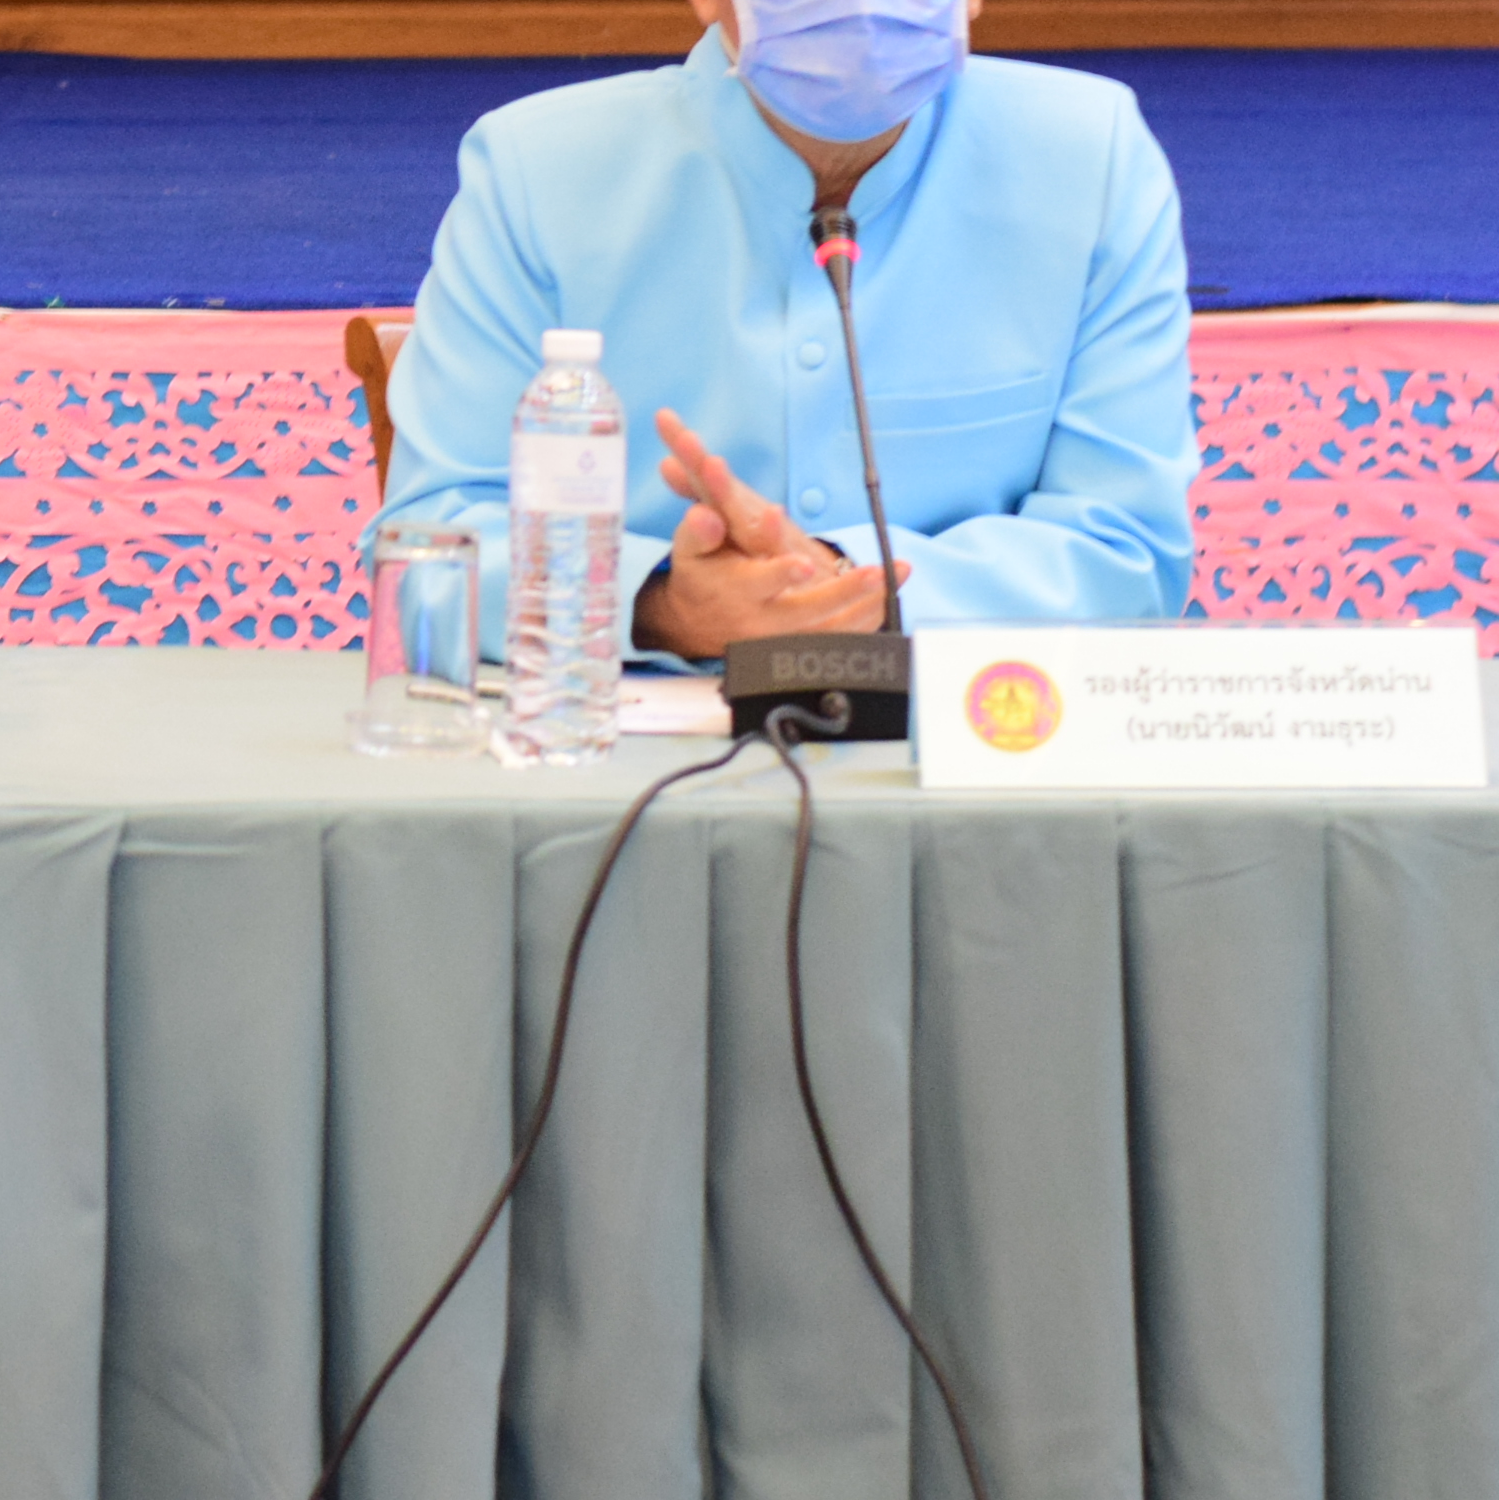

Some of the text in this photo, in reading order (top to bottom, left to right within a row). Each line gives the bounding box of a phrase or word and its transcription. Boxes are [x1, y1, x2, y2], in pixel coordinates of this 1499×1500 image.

[770, 649, 898, 683] BOSCH
[1082, 663, 1434, 705] รองผู้ว่าราชการจังหวัดน่าน
